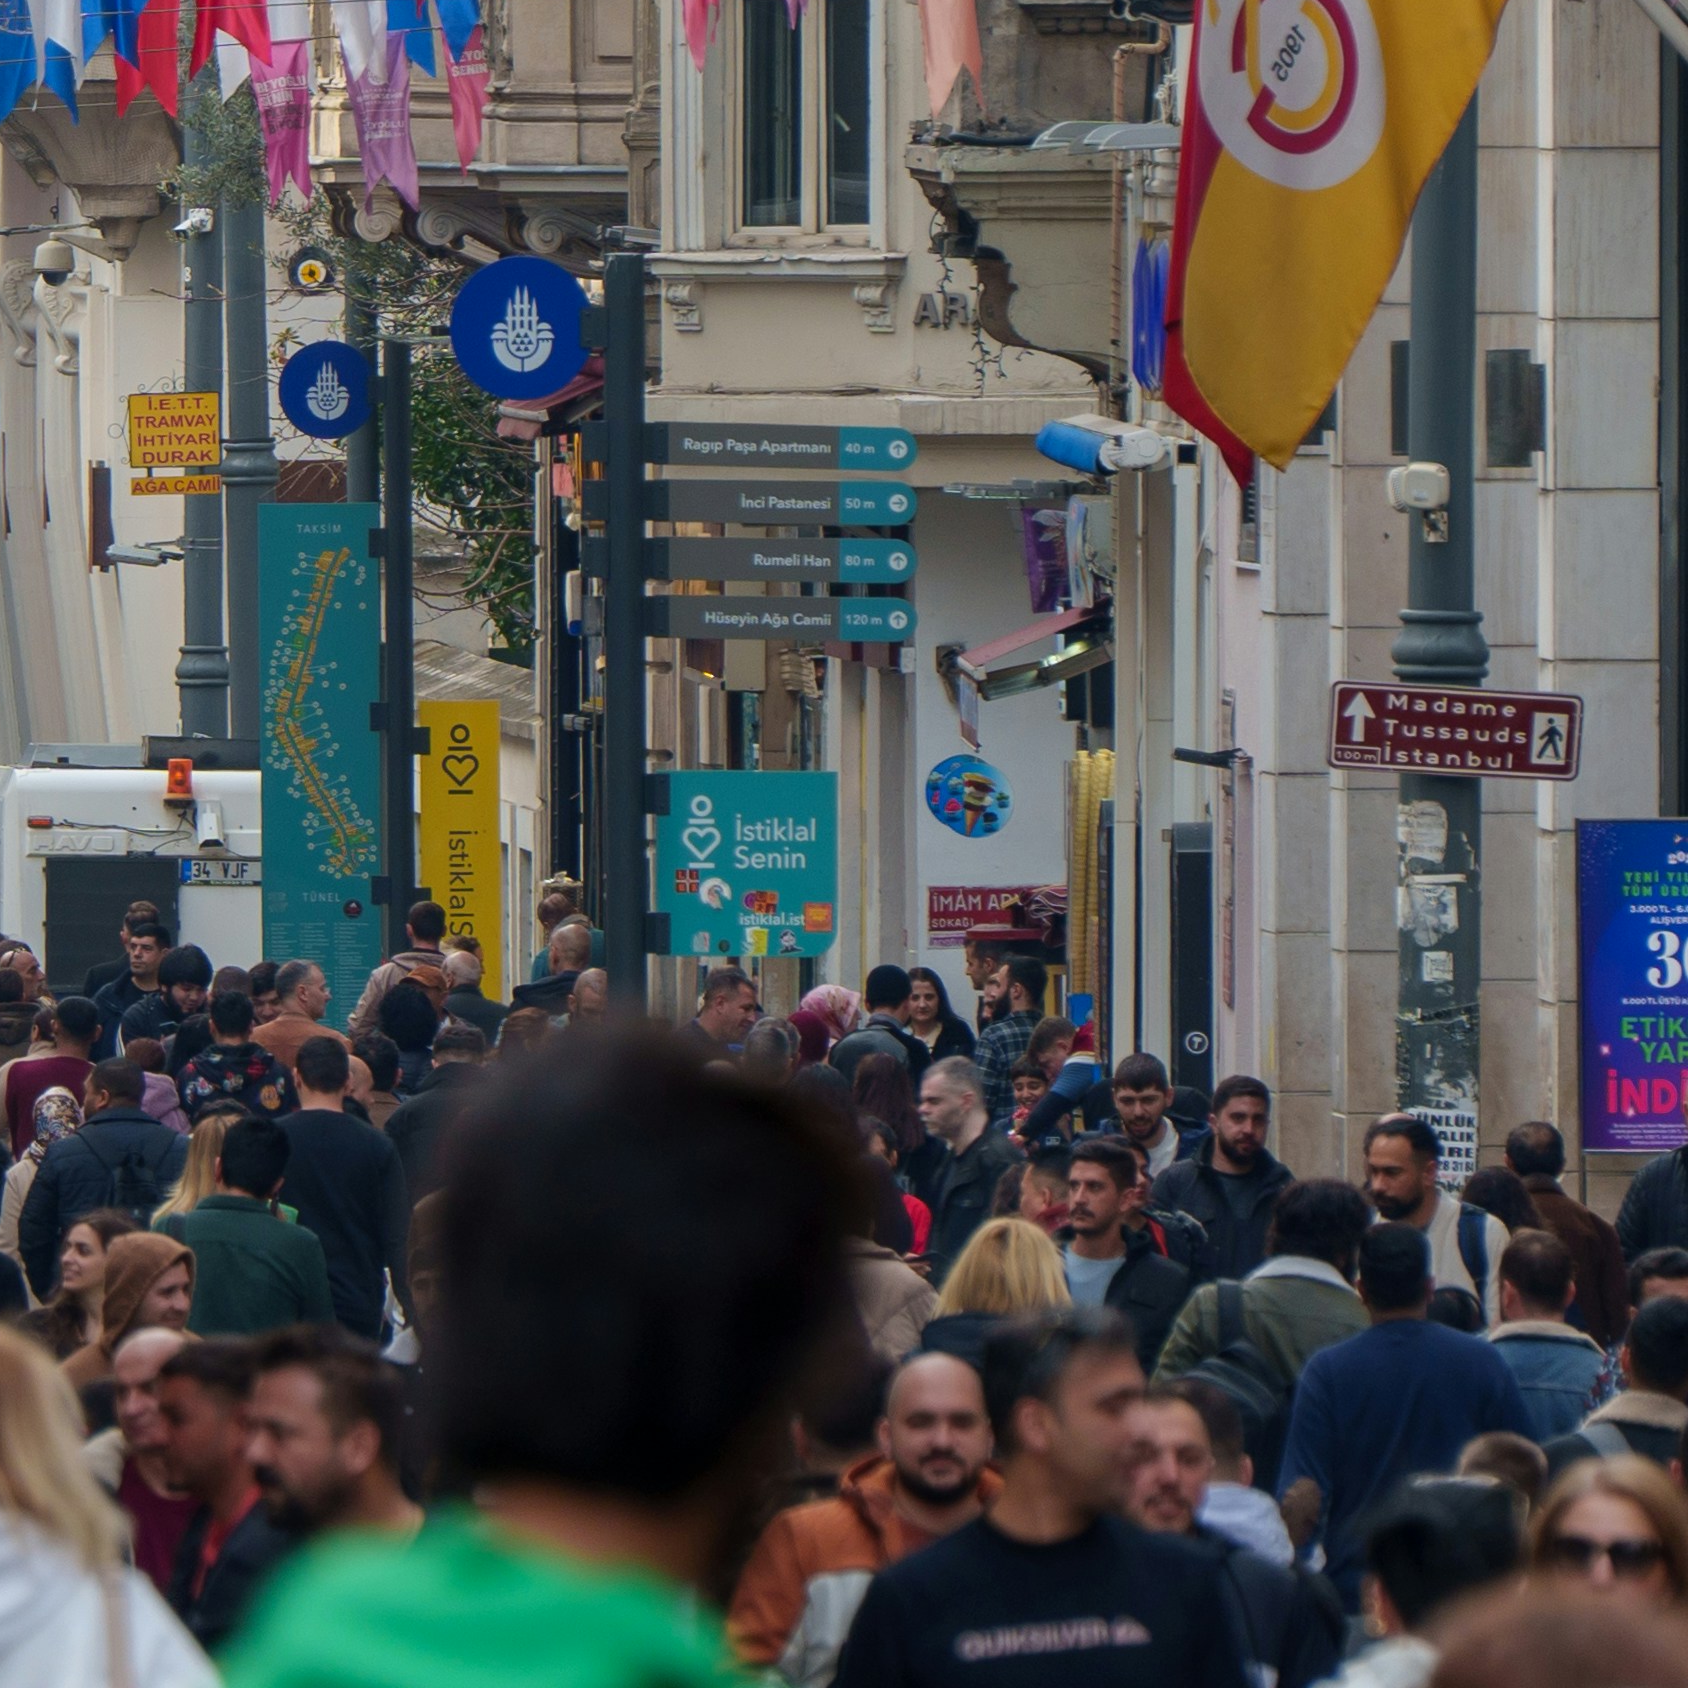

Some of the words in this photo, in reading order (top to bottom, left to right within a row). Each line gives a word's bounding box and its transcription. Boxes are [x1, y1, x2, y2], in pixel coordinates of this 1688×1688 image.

[148, 396, 208, 411] İ.E.T.T.
[134, 413, 216, 428] TRAMVAY
[137, 431, 216, 447] İHTİYARİ
[683, 438, 723, 454] Ragıp
[727, 439, 757, 455] Paşa
[760, 440, 831, 456] Apartmanı
[845, 443, 861, 454] 40
[863, 446, 875, 454] m
[142, 450, 213, 464] DURAK
[132, 477, 169, 492] AĞA
[174, 477, 222, 492] CAMİİ
[741, 493, 765, 509] İnci
[769, 495, 831, 509] Pastanesi
[845, 498, 861, 509] 50
[863, 500, 875, 509] m
[296, 523, 341, 533] TAKSİM
[753, 553, 800, 567] Rumeli
[803, 555, 831, 567] Han
[845, 556, 861, 567] 80
[863, 558, 875, 567] m
[705, 611, 759, 628] Hüseyin
[762, 612, 789, 628] Ağa
[793, 612, 831, 626] Camii
[846, 614, 868, 626] 120
[870, 616, 882, 625] m
[1388, 694, 1517, 718] Madame
[1385, 719, 1527, 745] Tussauds
[1384, 741, 1513, 770] İstanbul
[735, 814, 816, 841] İstiklal
[734, 846, 806, 869] Senin
[192, 862, 211, 878] 34
[221, 862, 249, 879] VJF
[302, 891, 340, 902] TÜNEL
[739, 912, 806, 926] istiklal.ist
[931, 916, 974, 928] SOKAĞI
[1647, 930, 1688, 989] 3
